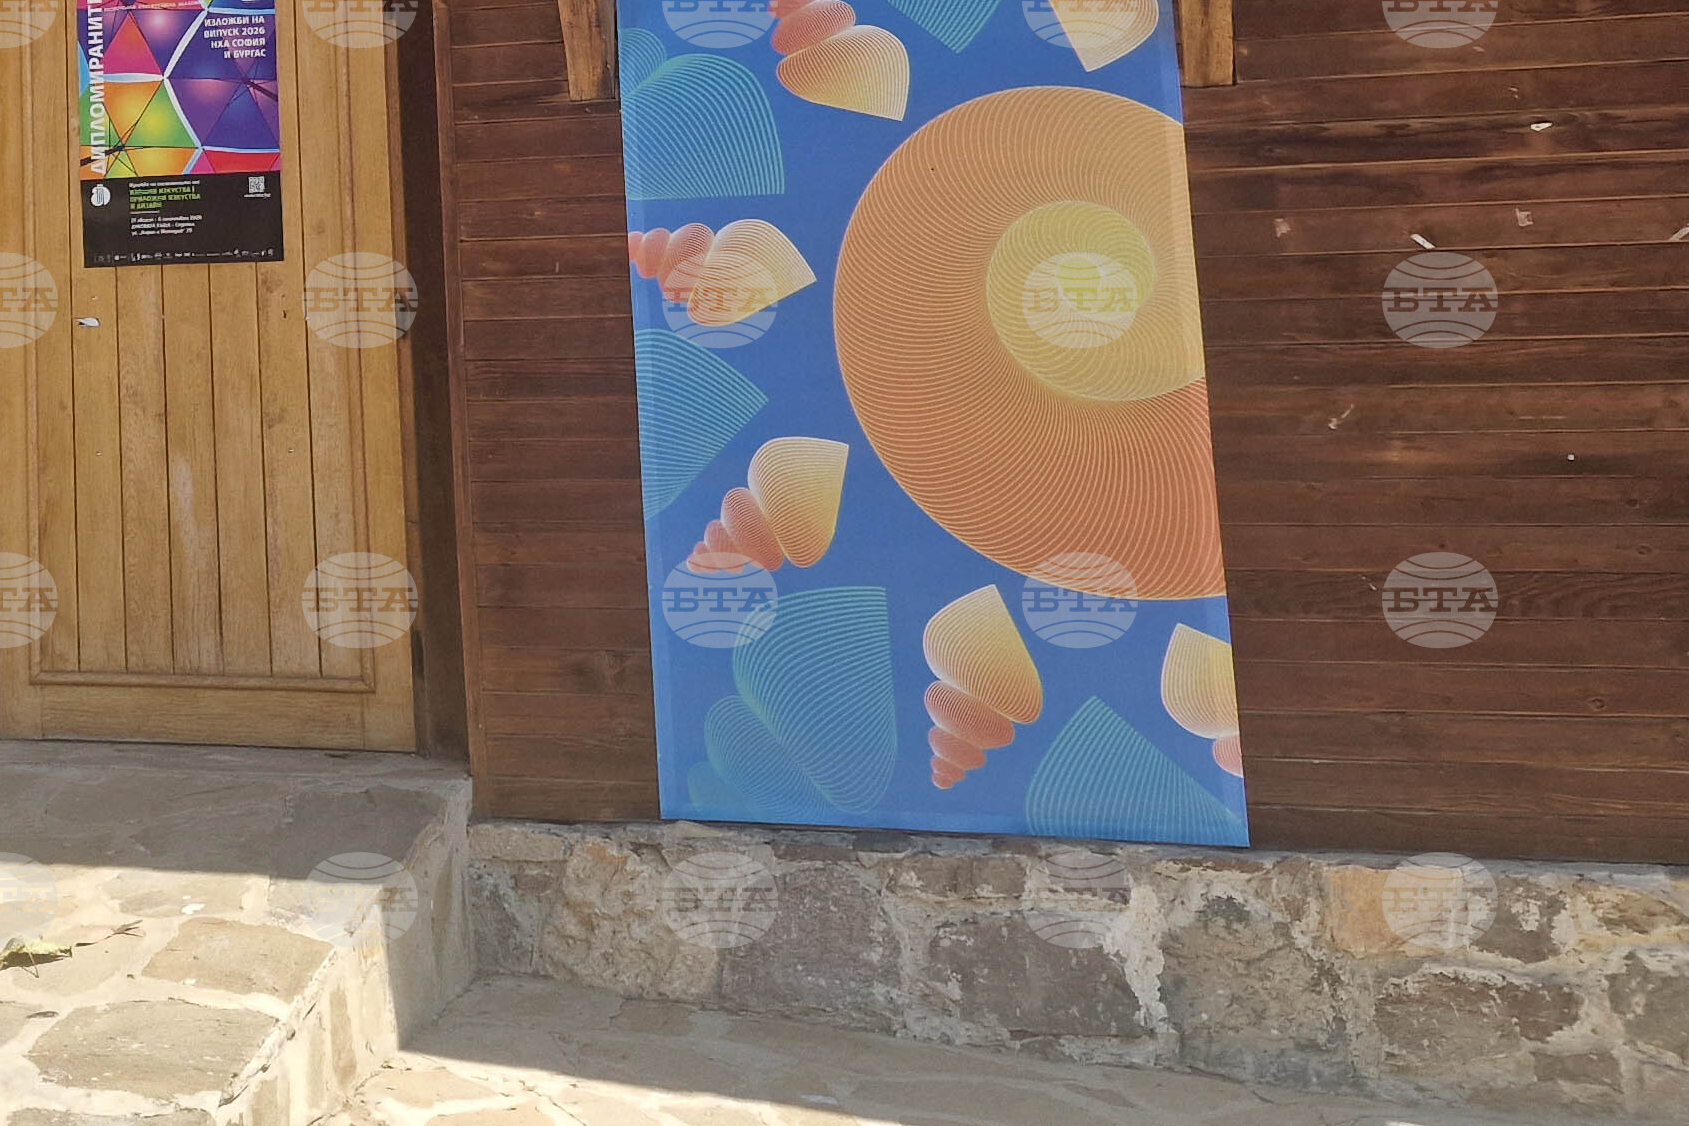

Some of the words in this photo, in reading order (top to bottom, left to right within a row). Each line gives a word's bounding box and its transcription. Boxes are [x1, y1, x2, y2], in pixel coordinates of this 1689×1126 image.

[204, 16, 249, 27] ИЗЛОЖБИ
[252, 15, 265, 24] НА
[242, 26, 266, 35] 2026
[211, 40, 230, 49] НХА
[232, 37, 266, 47] СОФИЯ
[223, 51, 231, 59] И
[233, 49, 267, 59] БУРГАС
